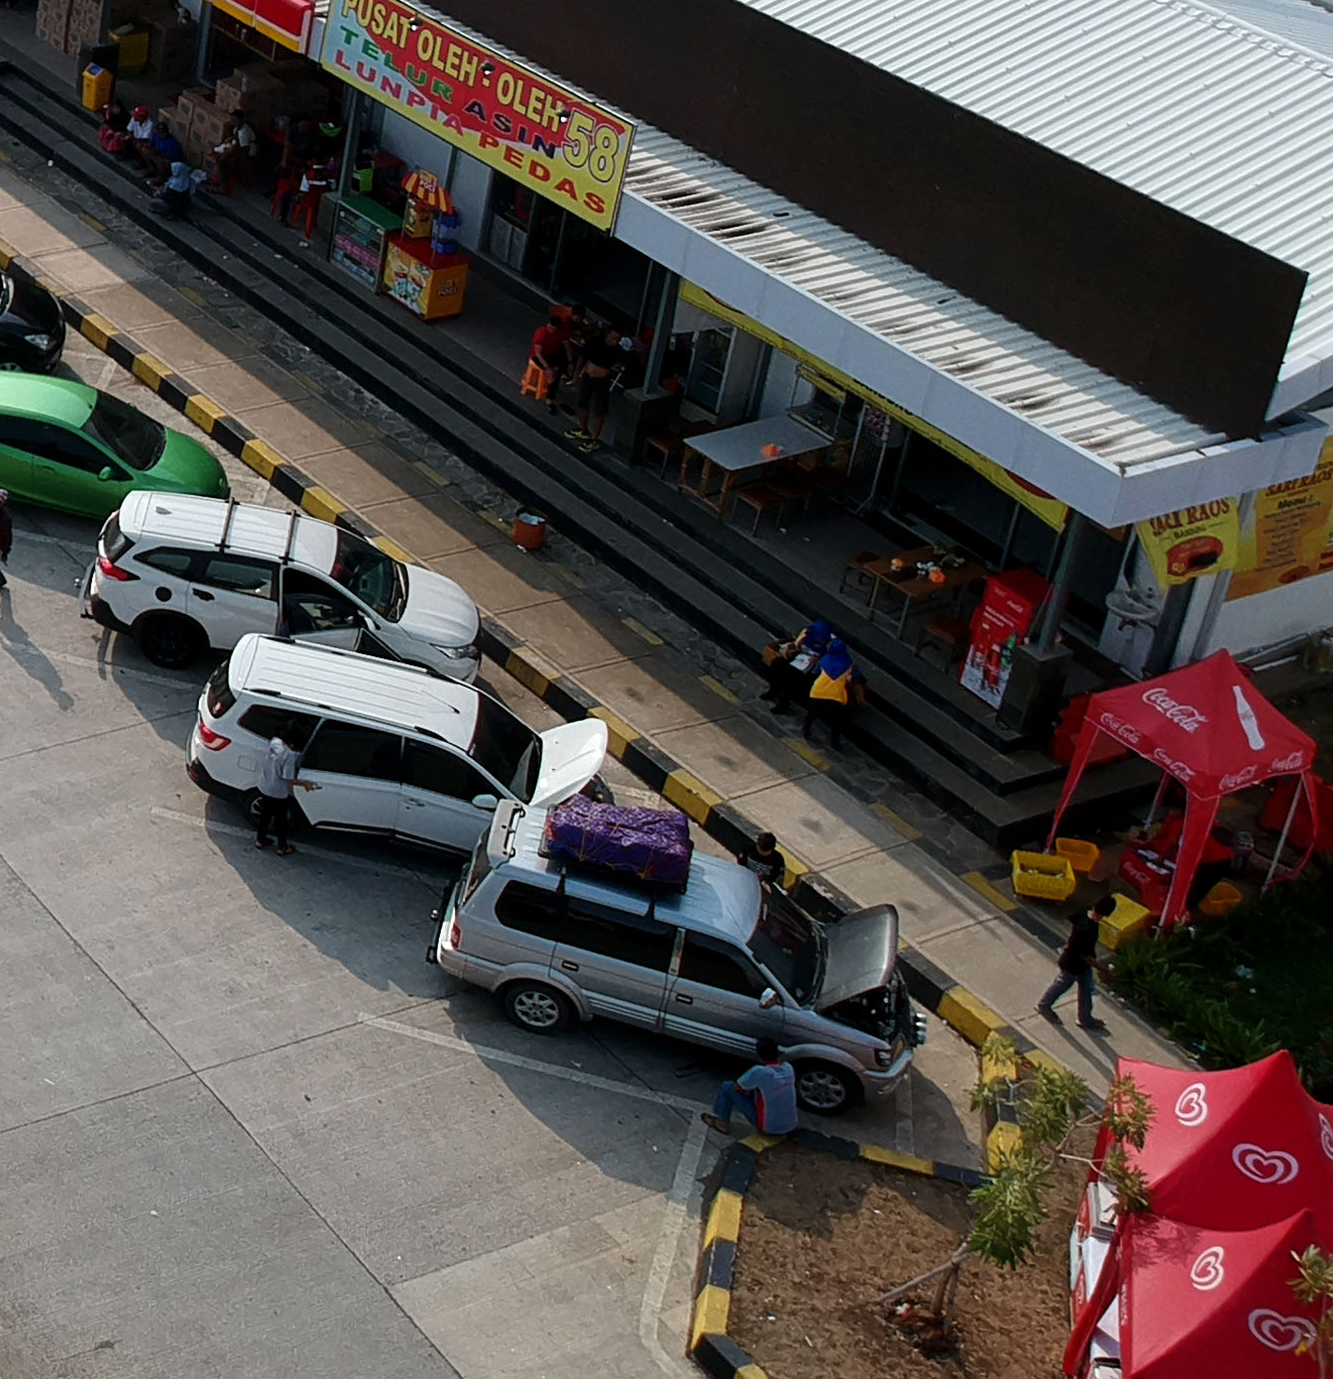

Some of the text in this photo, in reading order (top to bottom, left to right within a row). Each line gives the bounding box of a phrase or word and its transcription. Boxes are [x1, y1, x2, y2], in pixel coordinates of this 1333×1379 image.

[335, 49, 606, 214] LUNPIA PEDAS
[339, 25, 556, 160] TELUR ASIN
[562, 107, 620, 183] 58
[1183, 497, 1230, 525] RAOS
